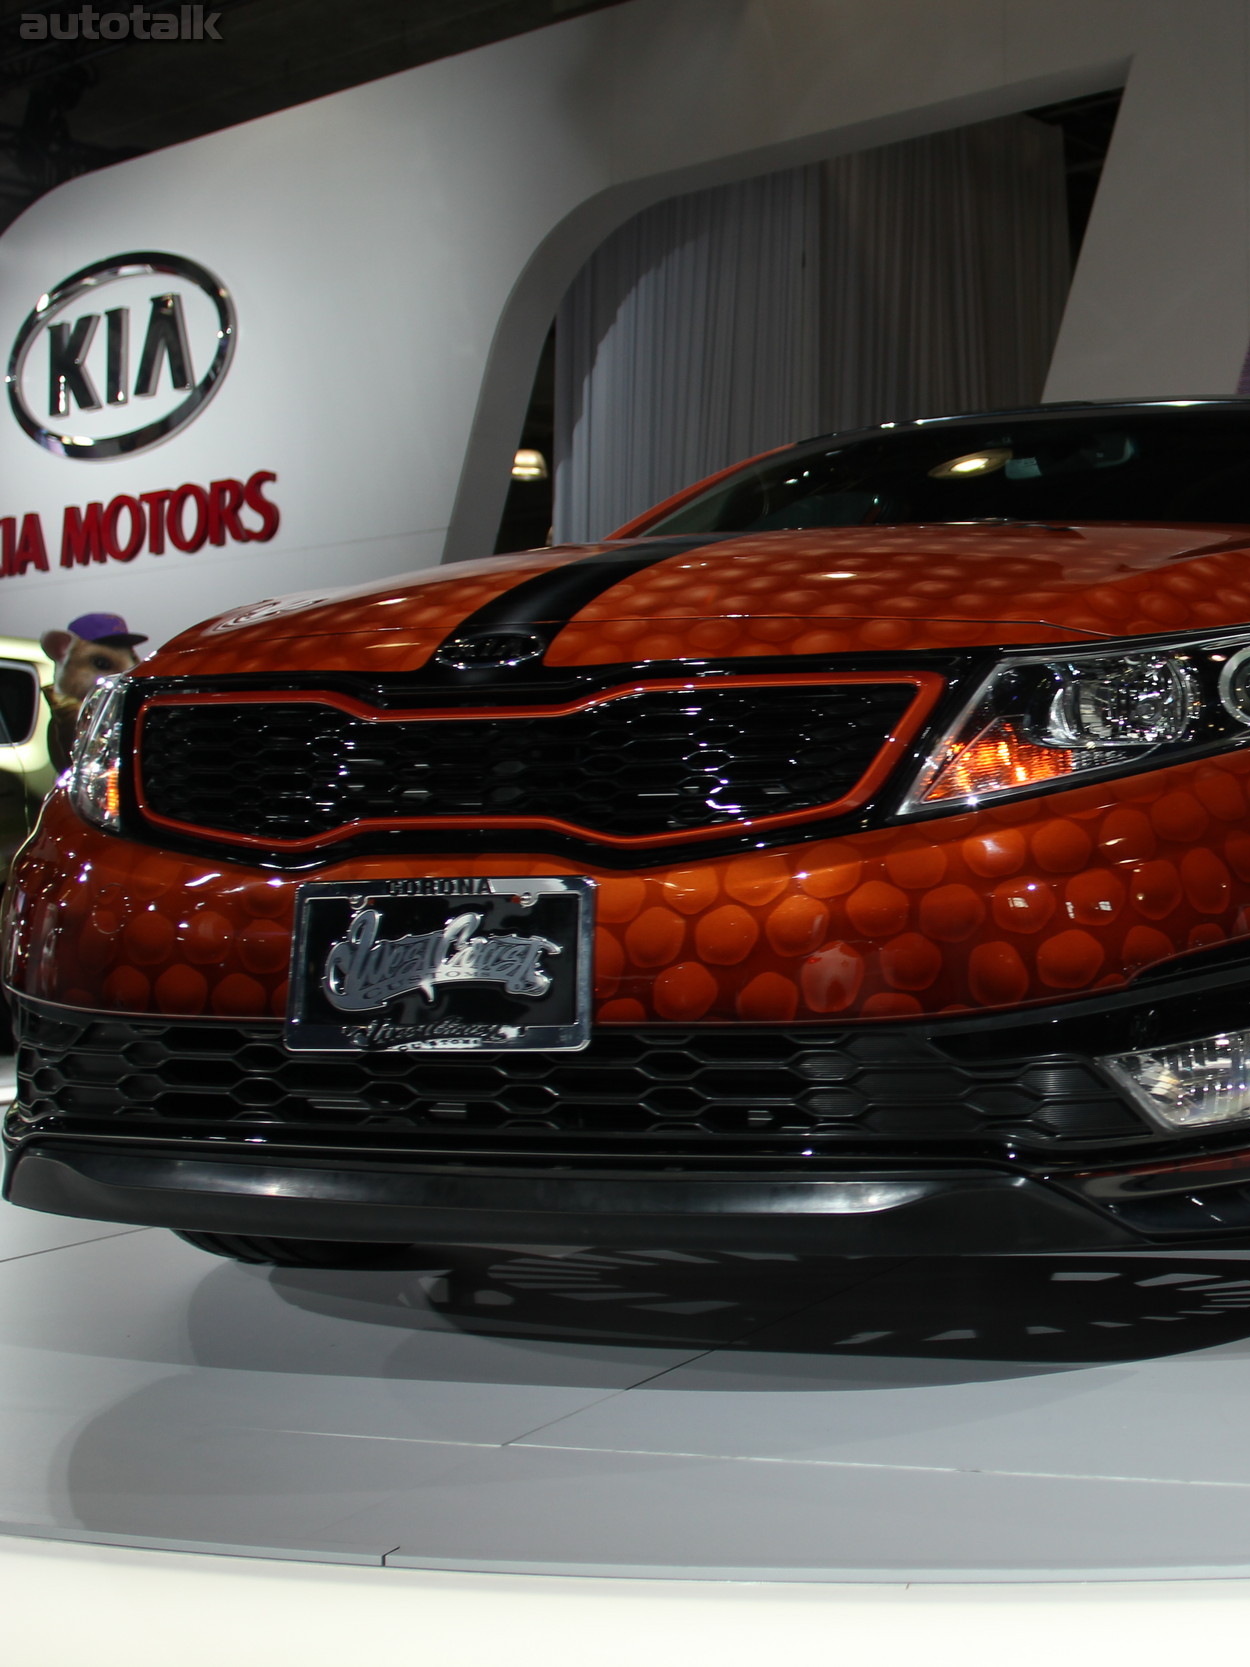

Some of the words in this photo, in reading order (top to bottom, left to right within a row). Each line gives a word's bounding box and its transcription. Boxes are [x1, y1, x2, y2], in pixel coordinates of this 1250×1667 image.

[48, 293, 195, 418] KIA
[0, 513, 50, 578] IA
[60, 470, 280, 568] MOTORS
[386, 878, 492, 896] CORONA
